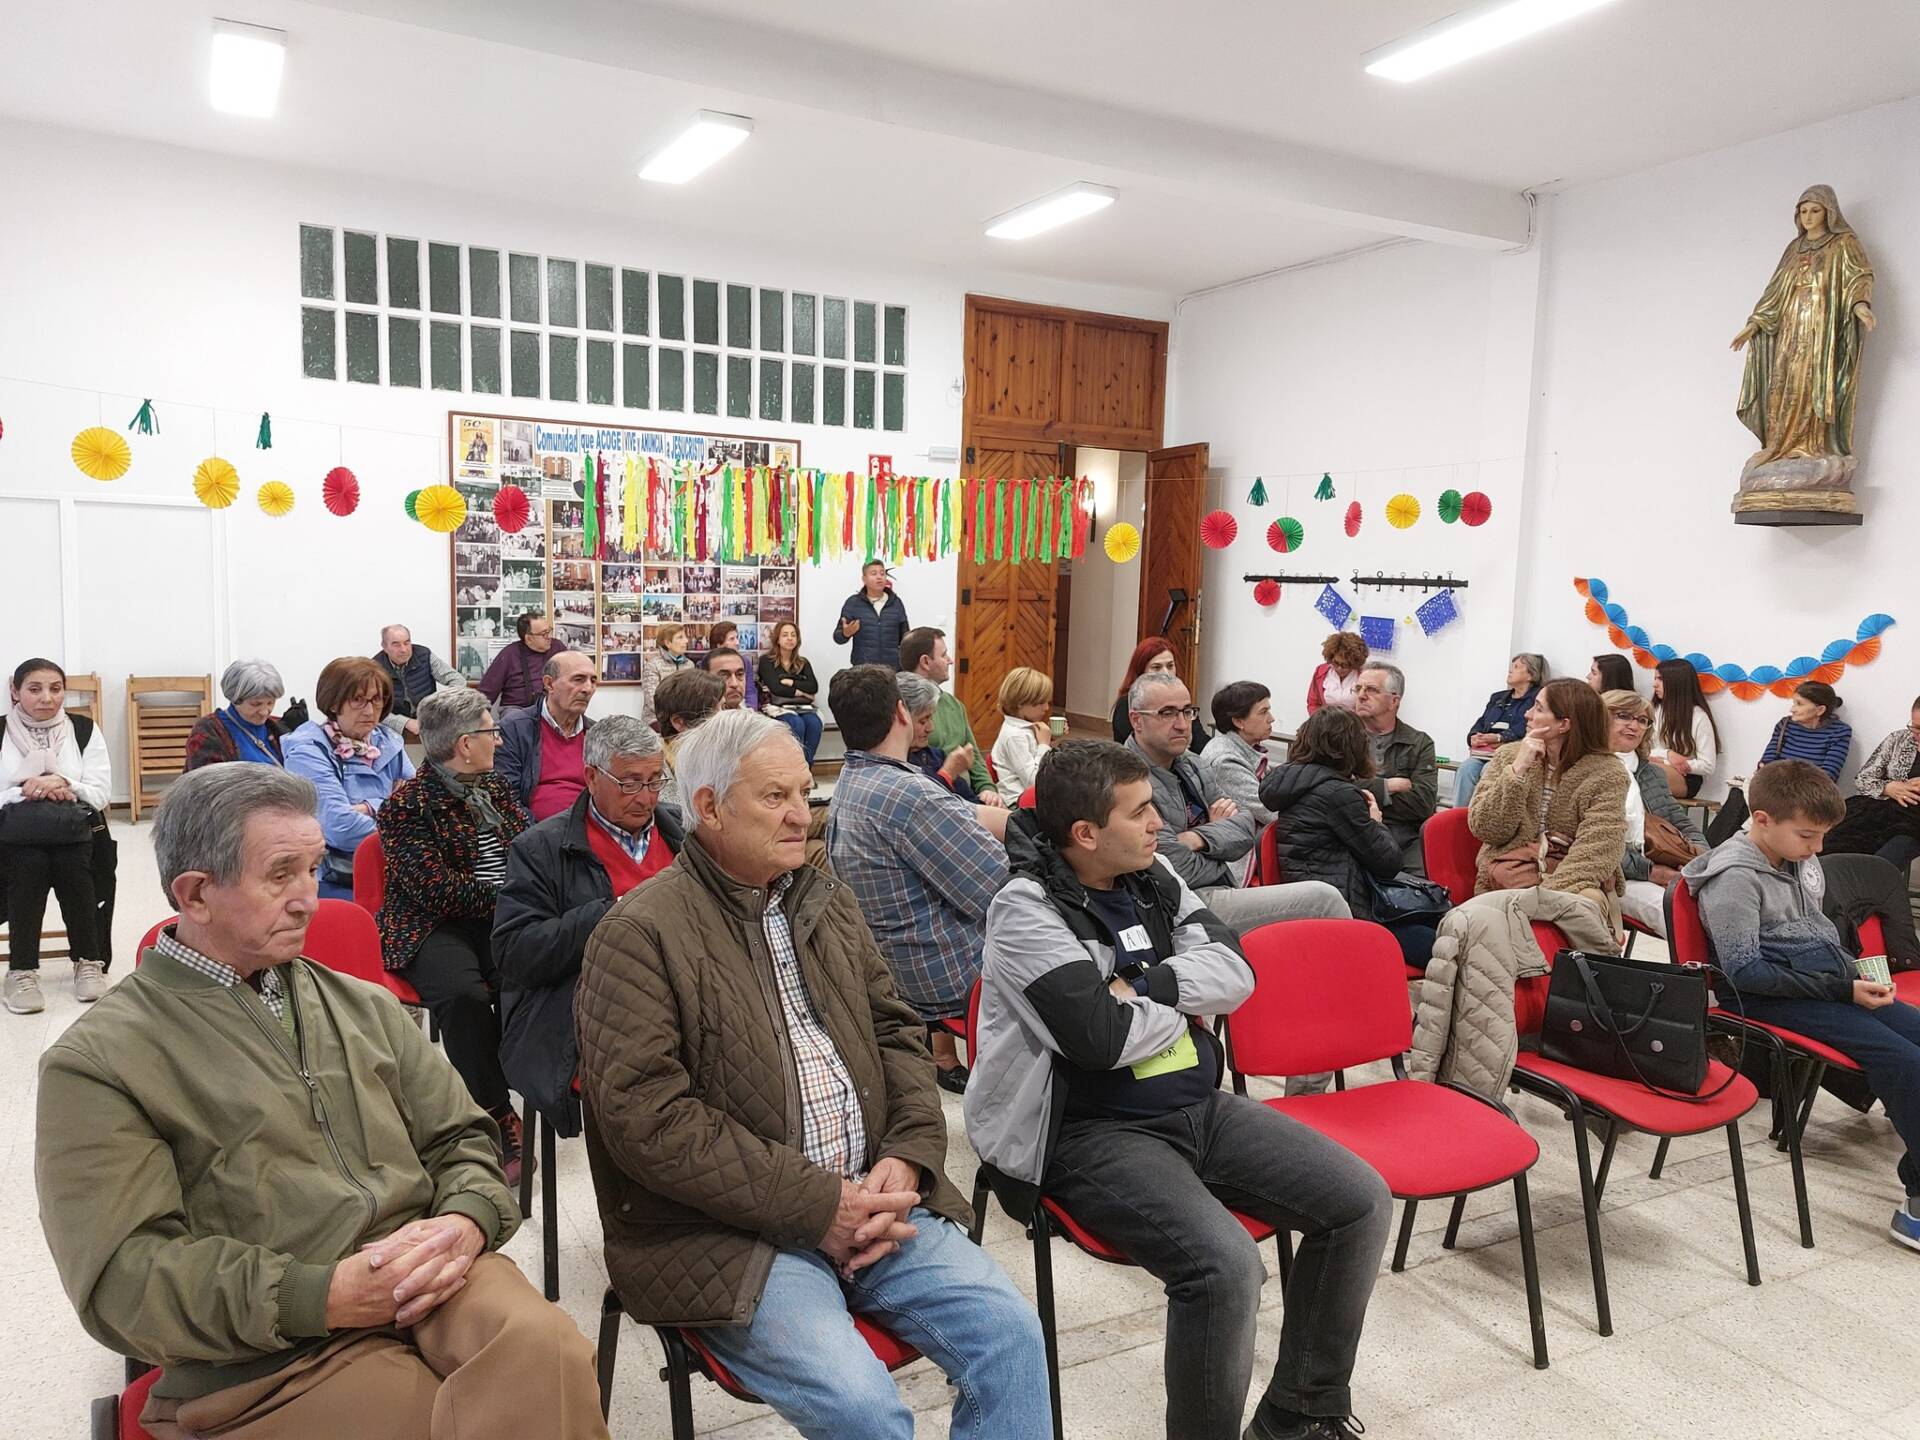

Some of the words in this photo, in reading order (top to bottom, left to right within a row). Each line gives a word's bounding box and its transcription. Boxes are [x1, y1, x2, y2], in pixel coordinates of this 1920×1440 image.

[536, 424, 579, 453] Comunidad
[580, 433, 595, 453] que
[596, 429, 622, 451] ACOGE
